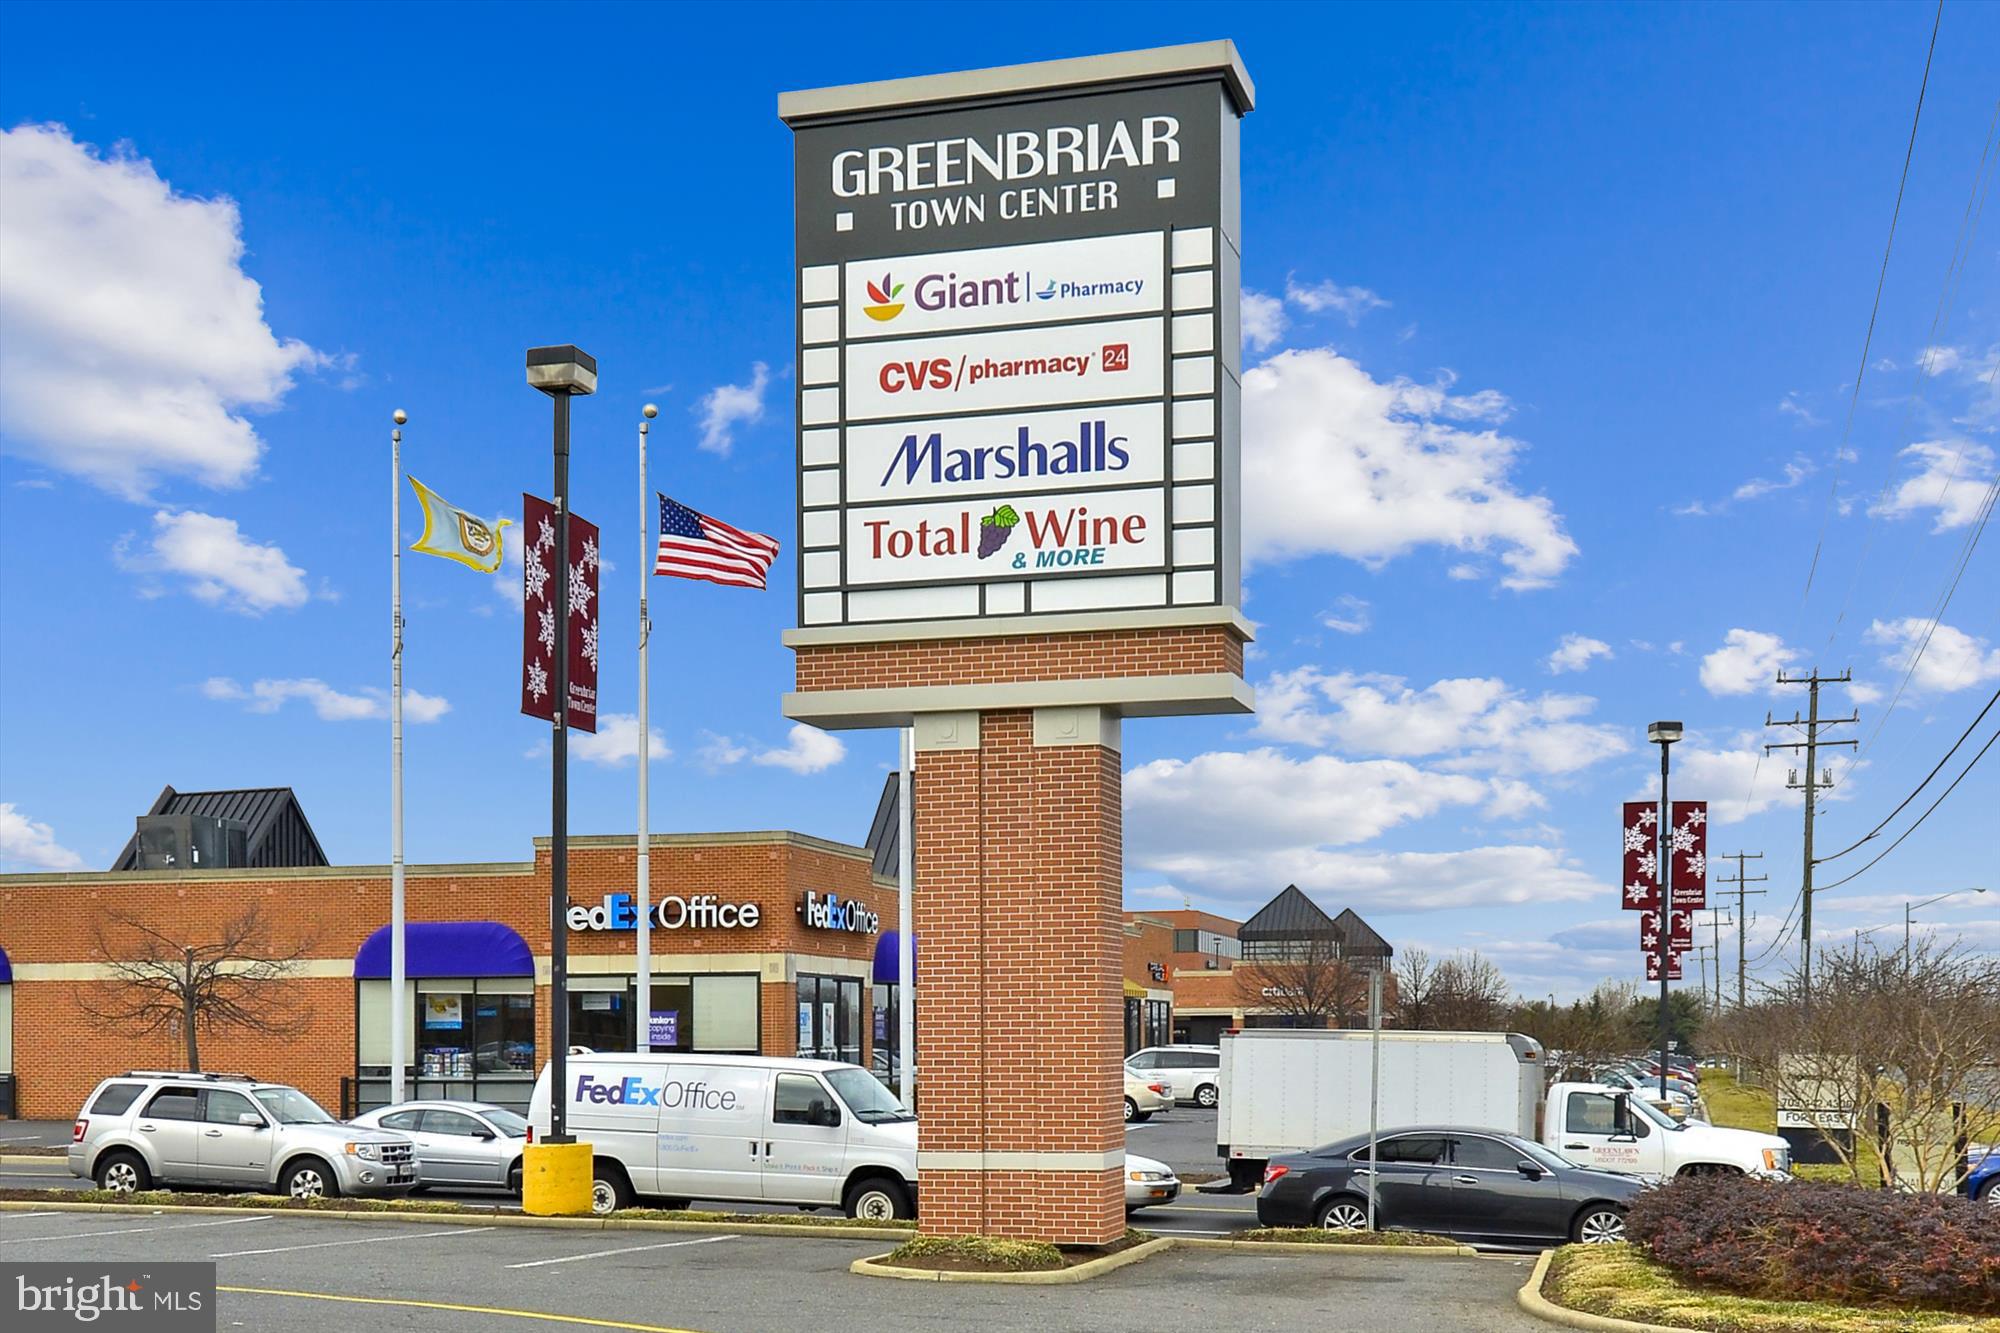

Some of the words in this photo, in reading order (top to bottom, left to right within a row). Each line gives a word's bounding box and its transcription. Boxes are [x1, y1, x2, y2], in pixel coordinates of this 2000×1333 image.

[832, 115, 1181, 198] GREENBRIAR
[891, 193, 985, 231] TOWN
[1000, 180, 1119, 220] CENTER
[914, 271, 1020, 311] Giant
[1061, 277, 1144, 299] Pharmacy
[1104, 348, 1127, 368] 24
[881, 421, 1130, 487] Marshalls
[863, 512, 970, 559] Total
[1025, 507, 1146, 549] Wine
[1011, 552, 1027, 570] &
[1035, 547, 1105, 569] MORE
[550, 893, 656, 931] edEx
[658, 895, 759, 929] Office
[807, 890, 846, 930] FedEx
[846, 900, 878, 935] Office
[575, 1075, 661, 1107] FedEx
[662, 1081, 736, 1110] Office
[1786, 1112, 1808, 1122] FOR
